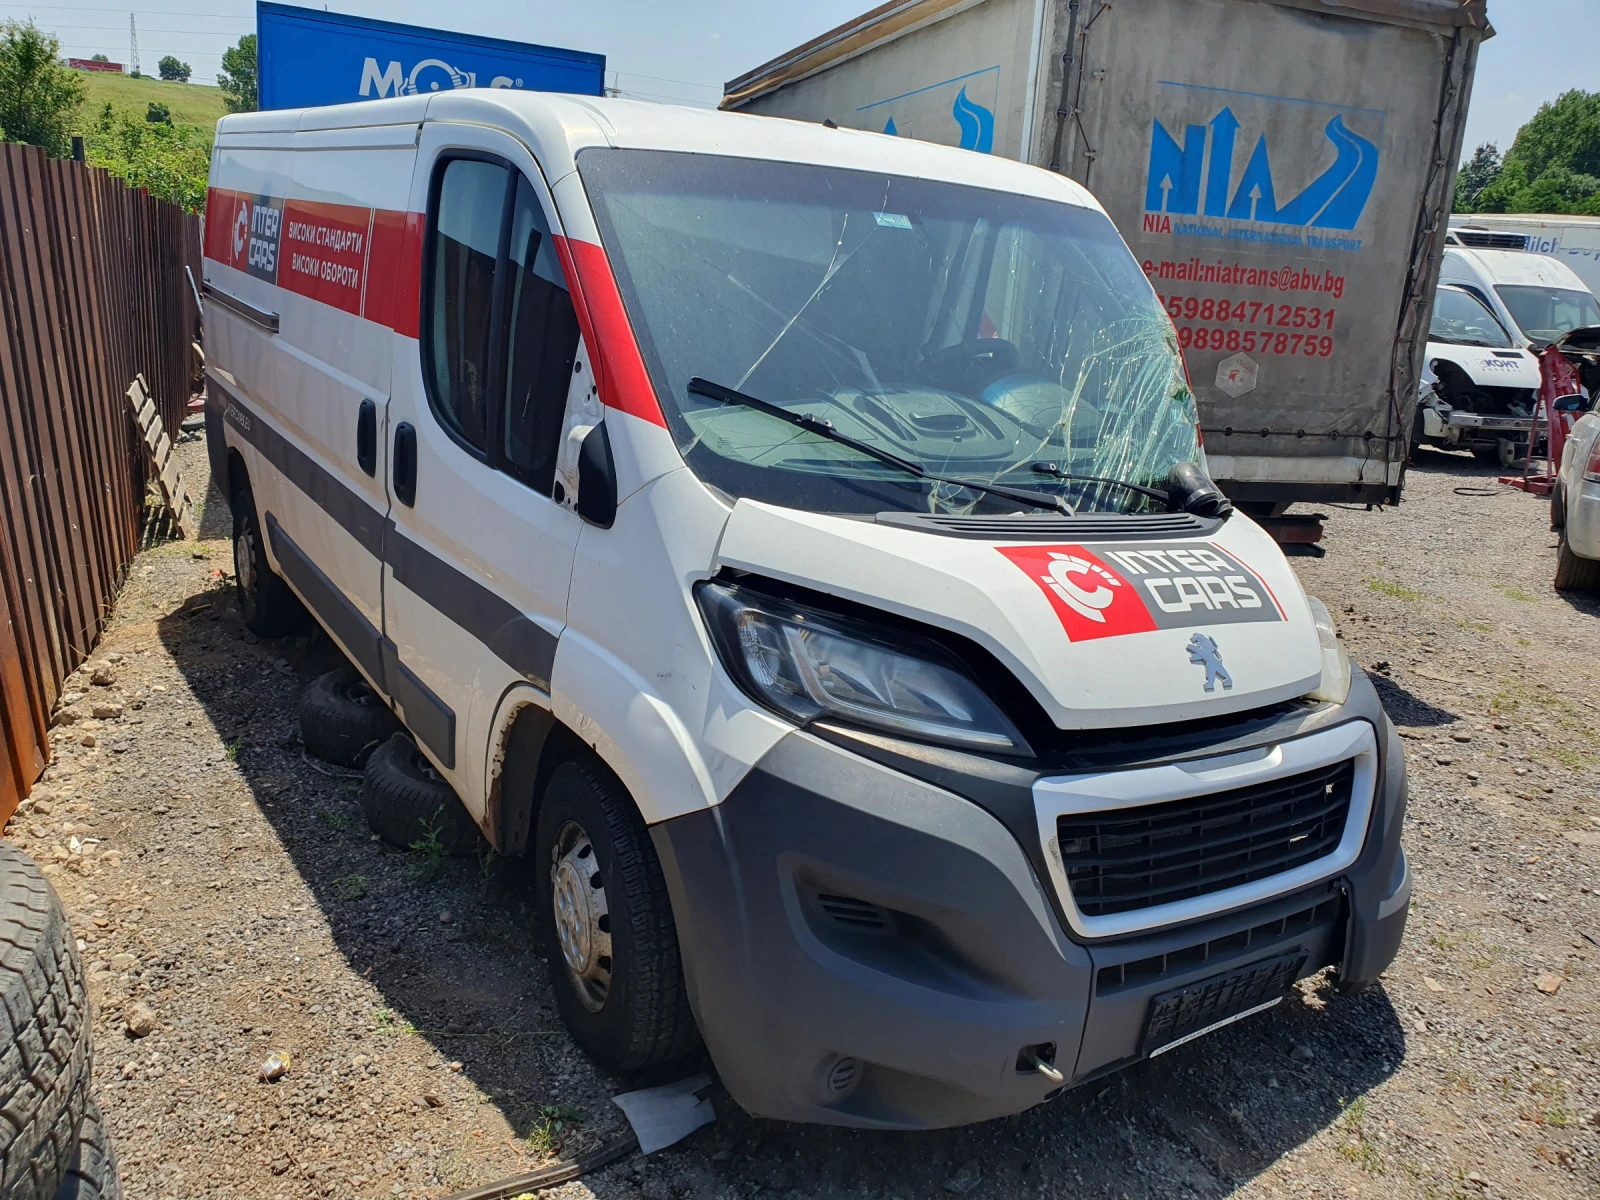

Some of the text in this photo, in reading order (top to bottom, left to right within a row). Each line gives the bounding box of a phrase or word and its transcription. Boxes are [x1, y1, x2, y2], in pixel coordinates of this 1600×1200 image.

[251, 205, 279, 238] INTER
[288, 221, 363, 254] ВИСОКИ СТАНДАРТИ
[1143, 213, 1171, 234] NIA
[1307, 236, 1363, 251] TRANSPORT
[249, 238, 275, 271] CARS
[292, 252, 359, 290] ВИСОКИ ОБОРОТИ
[1104, 549, 1237, 575] INTER
[1143, 575, 1263, 613] CARS
